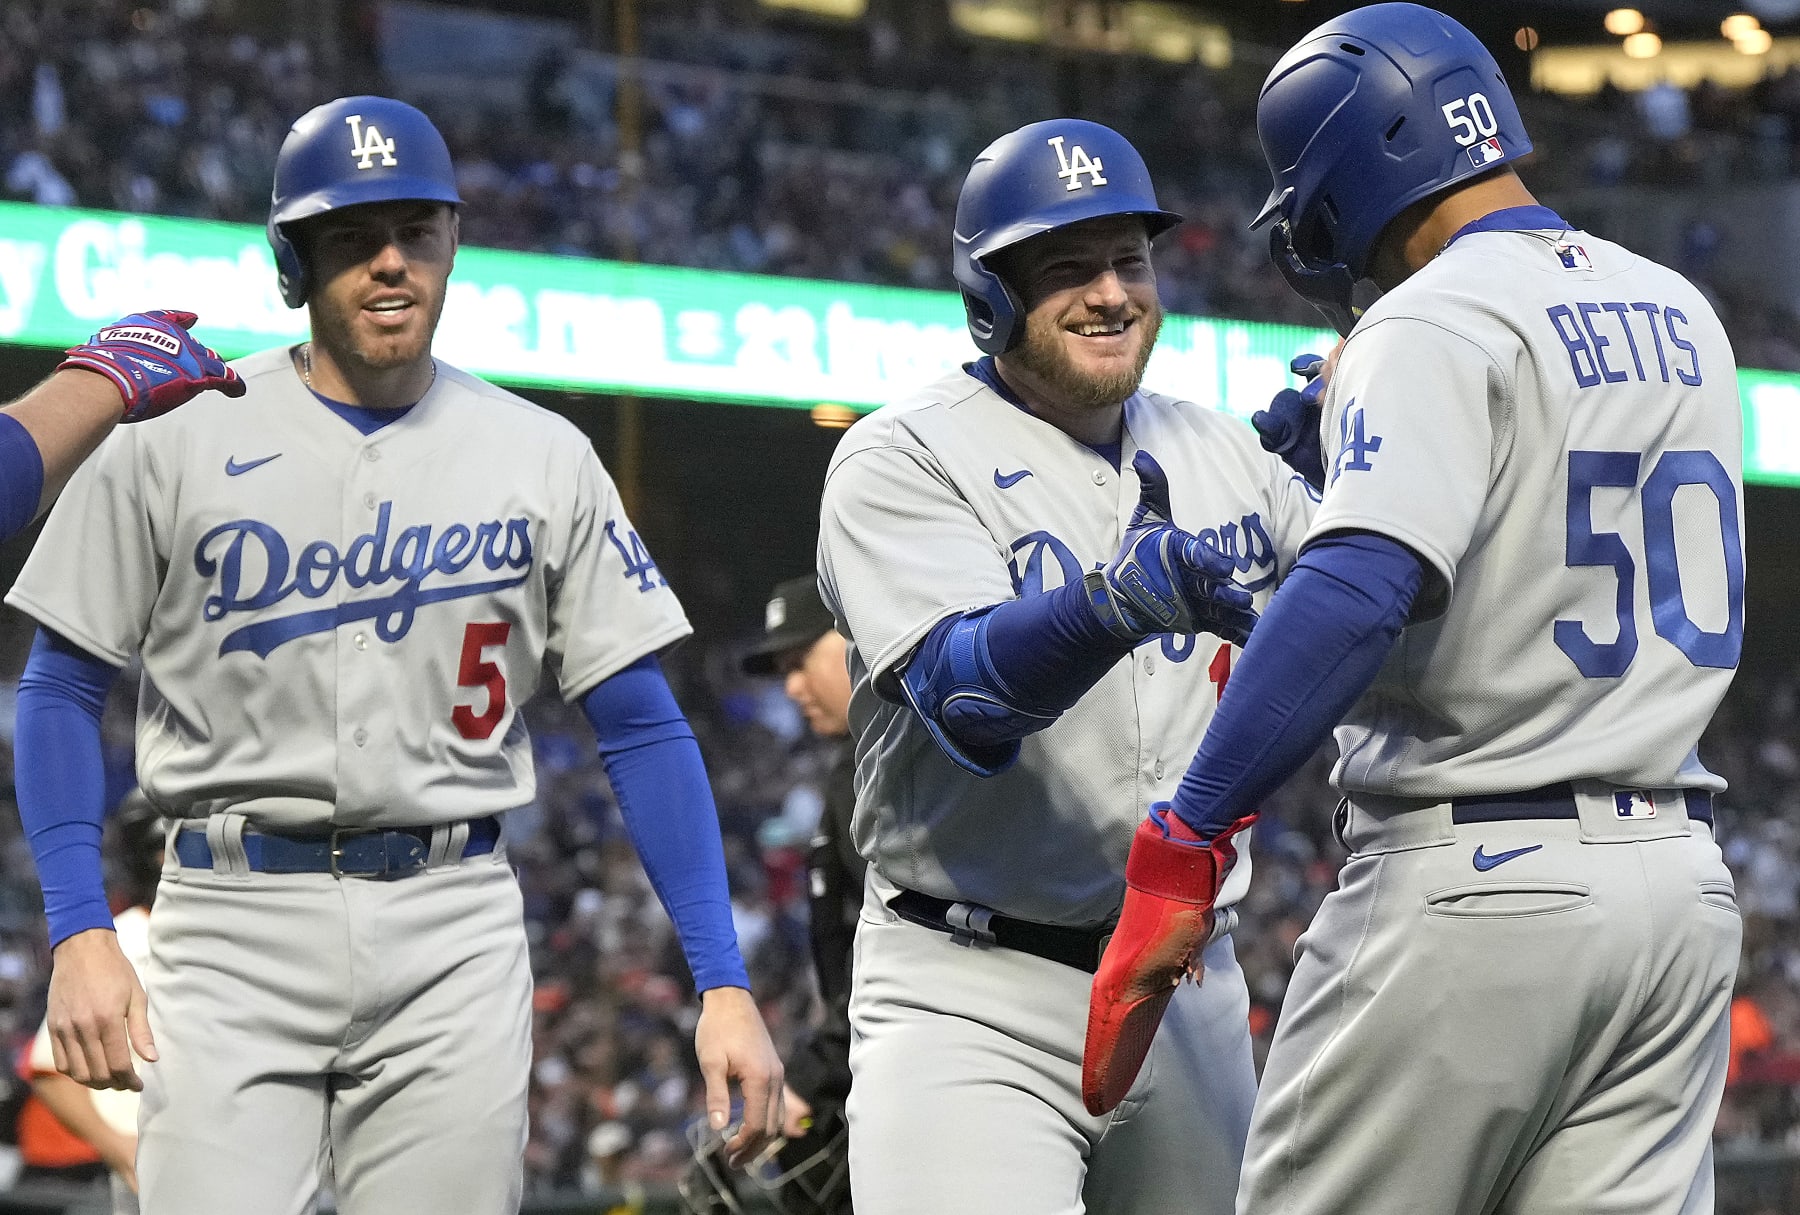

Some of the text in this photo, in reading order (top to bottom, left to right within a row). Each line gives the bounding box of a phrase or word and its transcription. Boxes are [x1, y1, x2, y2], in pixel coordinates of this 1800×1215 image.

[346, 115, 397, 169] LA
[1441, 92, 1498, 146] 50
[1048, 136, 1107, 191] LA
[105, 330, 177, 350] franklin
[1546, 302, 1703, 388] BETTS
[195, 500, 533, 644] Dodgers
[1553, 450, 1744, 679] 50
[451, 623, 511, 739] 5
